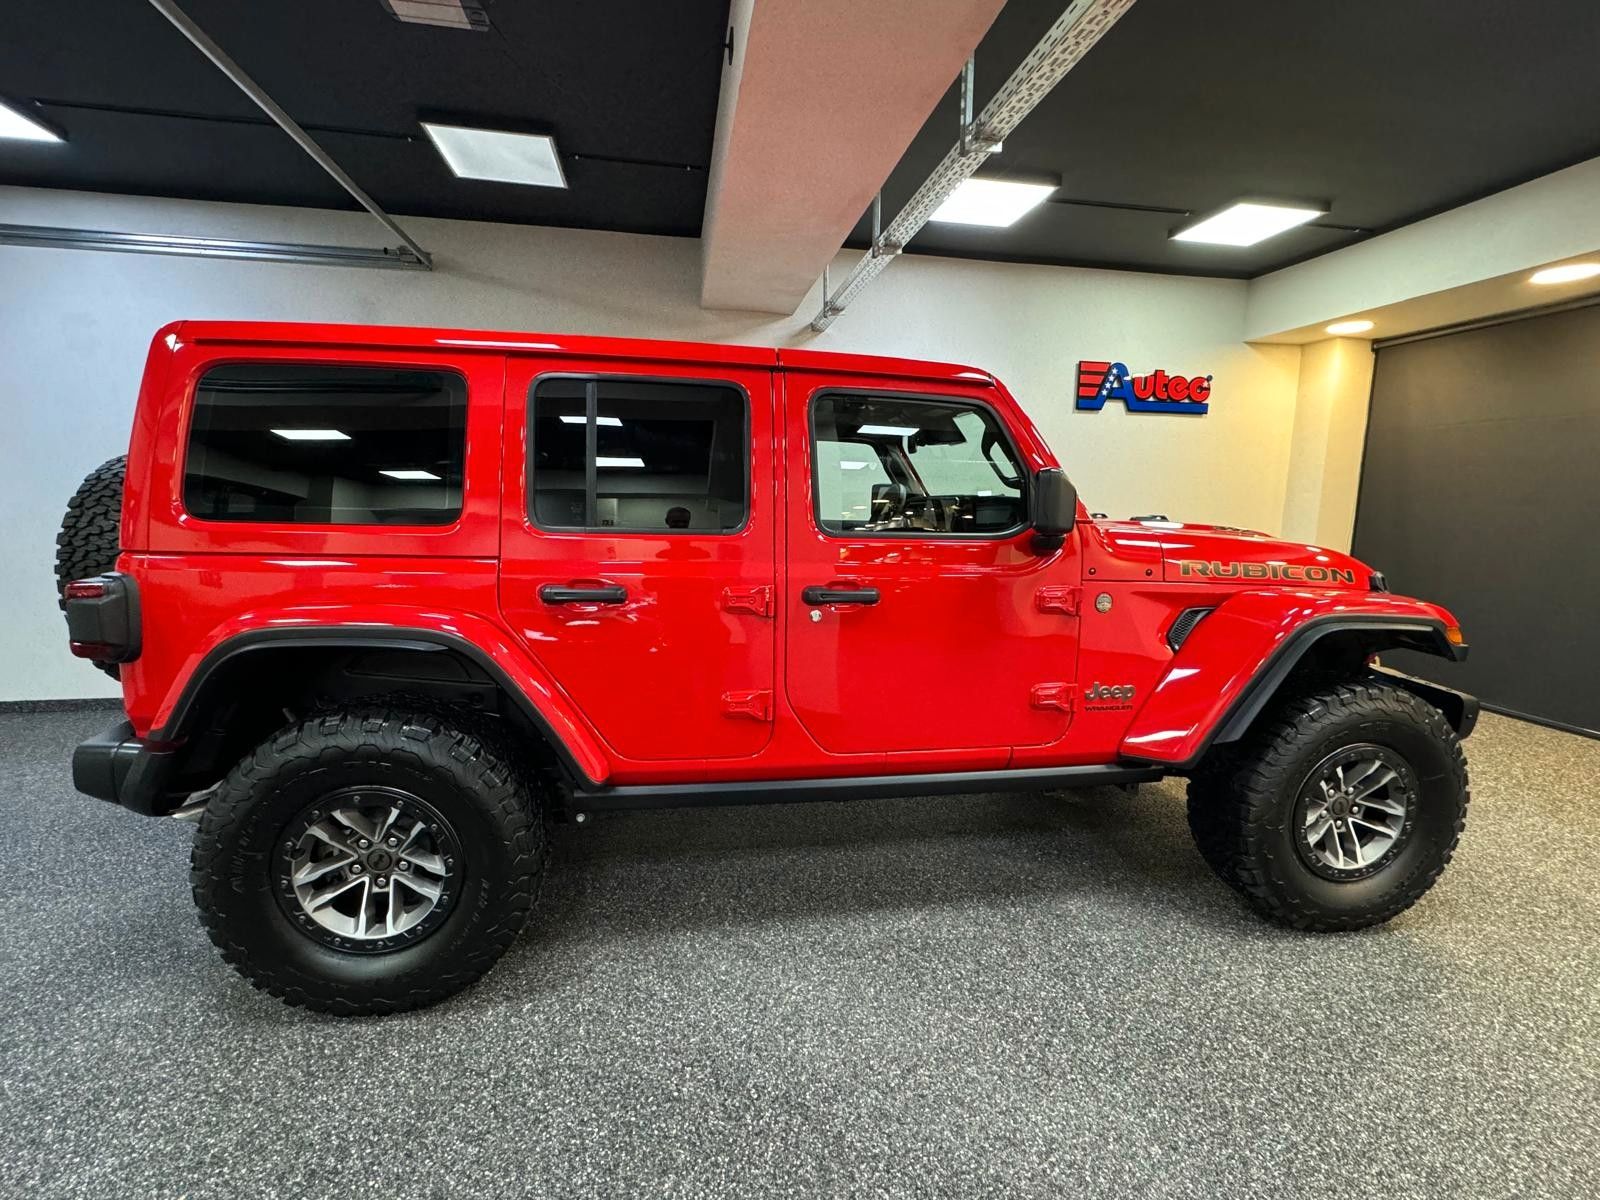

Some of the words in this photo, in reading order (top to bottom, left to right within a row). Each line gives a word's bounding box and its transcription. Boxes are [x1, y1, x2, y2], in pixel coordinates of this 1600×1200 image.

[1077, 361, 1211, 414] Autec
[1179, 560, 1355, 584] RUBICON
[1085, 681, 1136, 702] Jeep
[1085, 704, 1133, 712] WRANGLER
